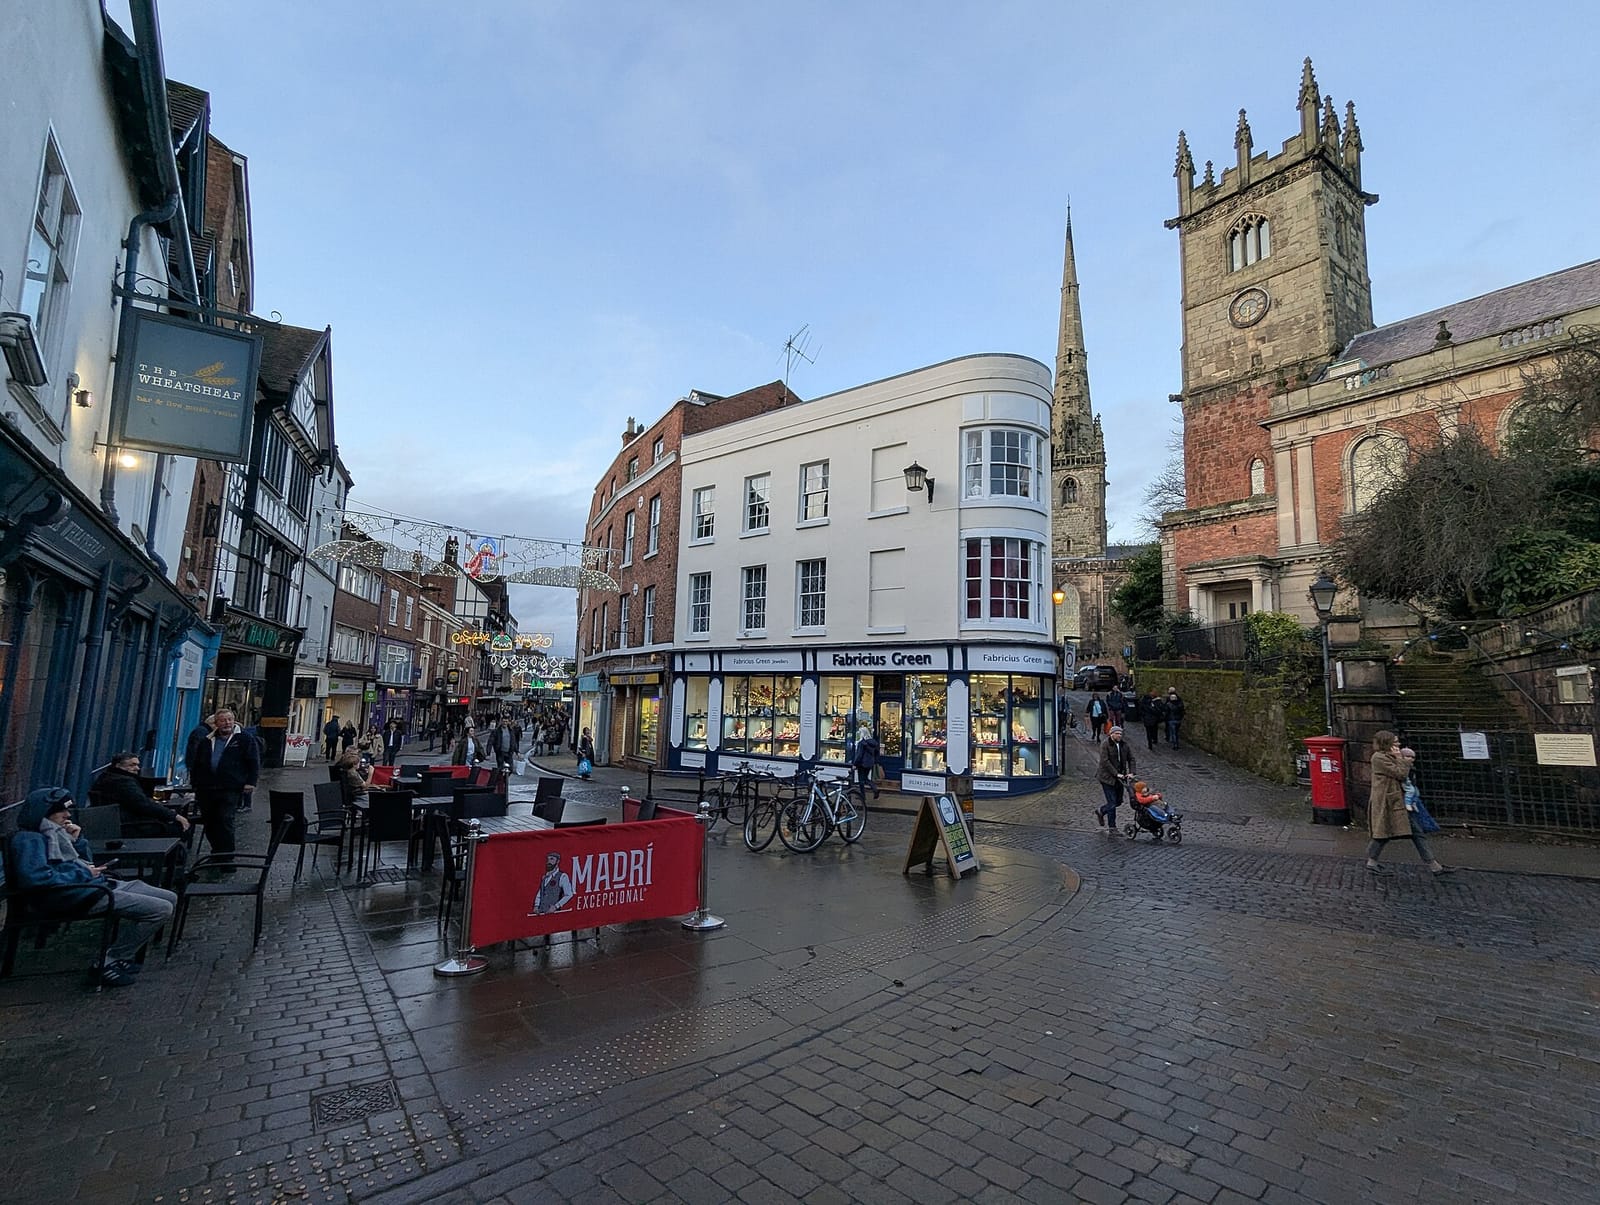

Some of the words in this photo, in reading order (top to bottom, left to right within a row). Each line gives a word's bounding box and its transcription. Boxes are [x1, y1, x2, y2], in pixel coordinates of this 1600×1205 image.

[139, 363, 177, 377] THE
[138, 373, 242, 401] WHEATSHEAF
[756, 657, 771, 665] Green
[832, 652, 887, 667] Fabricius
[891, 652, 932, 666] Green
[983, 653, 1020, 663] Fabricius
[1023, 655, 1042, 664] Green
[571, 842, 653, 895] MADRÍ
[576, 888, 645, 910] EXCEPCIONAL
